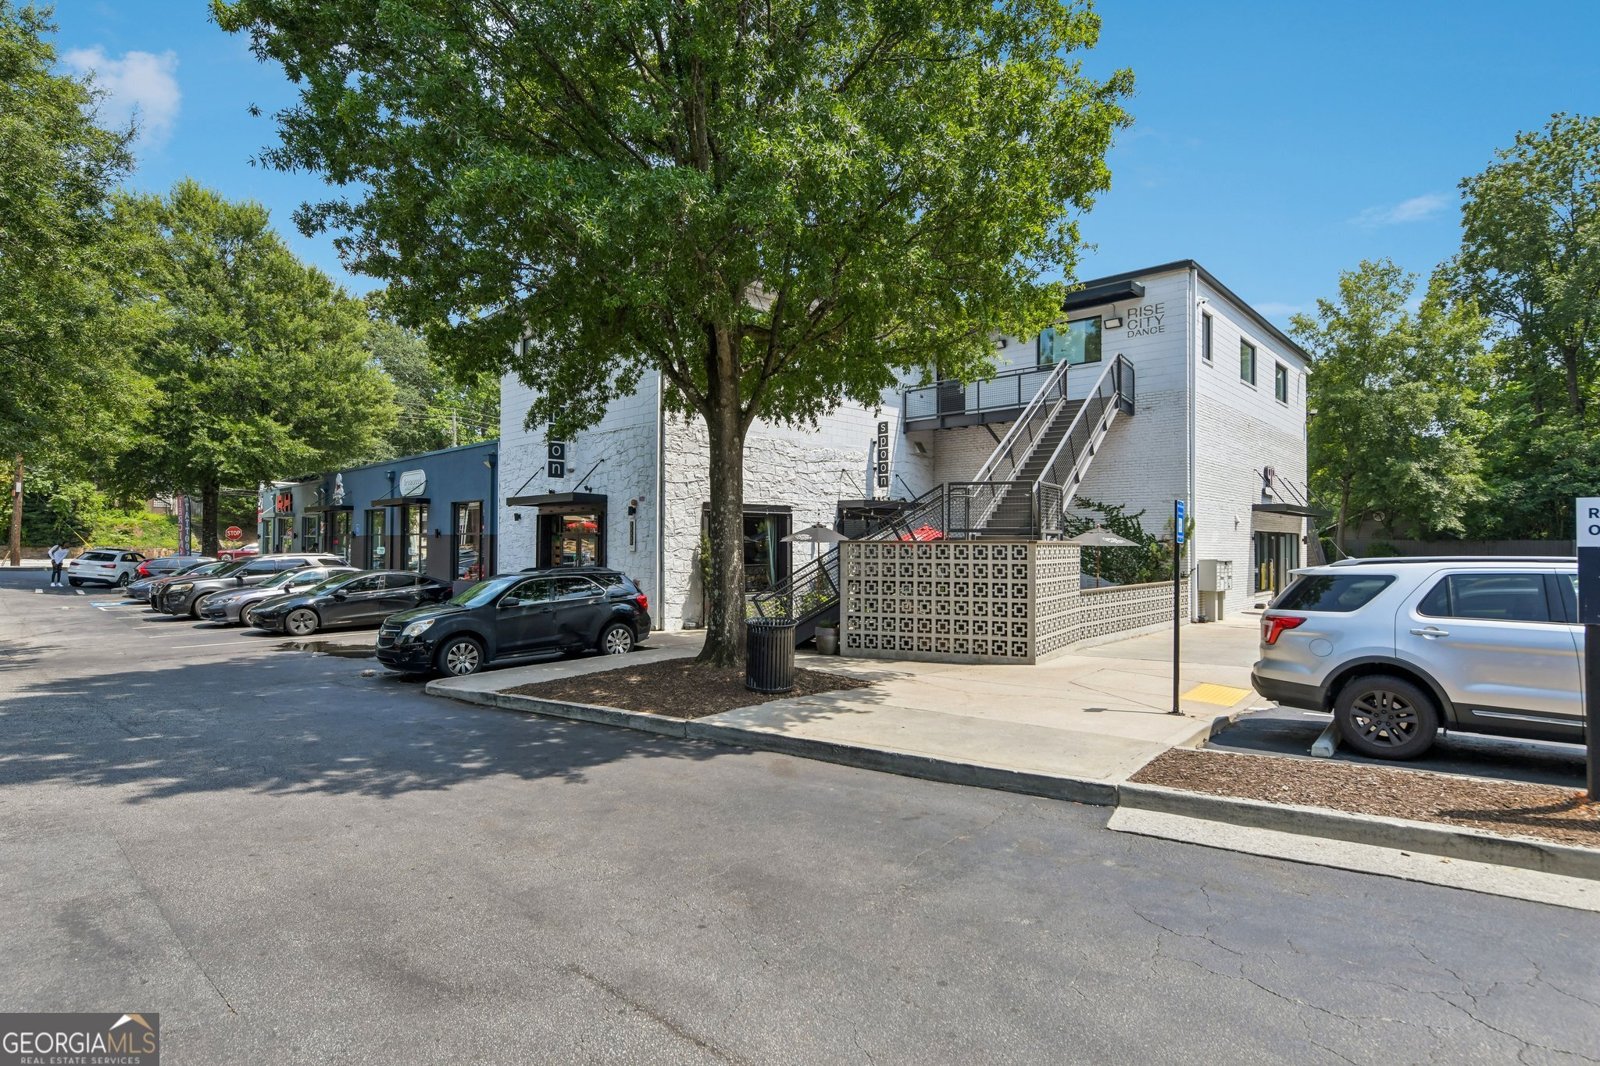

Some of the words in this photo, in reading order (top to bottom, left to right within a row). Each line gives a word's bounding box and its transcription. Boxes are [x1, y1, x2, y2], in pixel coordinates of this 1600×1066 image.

[1127, 302, 1165, 319] RISE
[1127, 314, 1165, 330] CITY
[1127, 325, 1165, 338] DANCE
